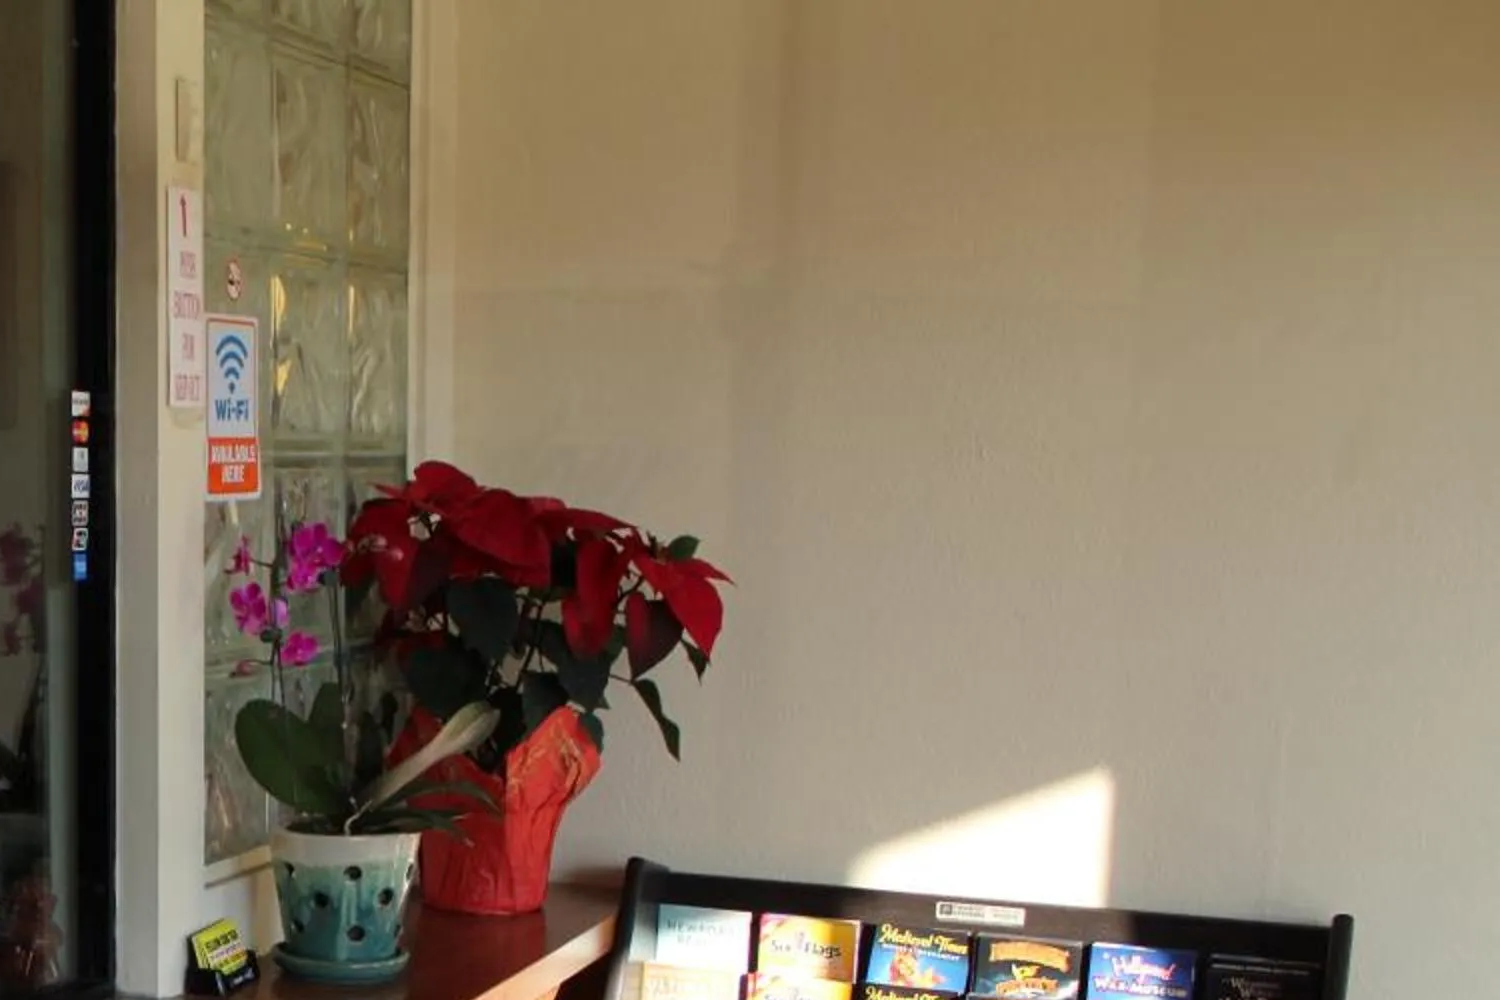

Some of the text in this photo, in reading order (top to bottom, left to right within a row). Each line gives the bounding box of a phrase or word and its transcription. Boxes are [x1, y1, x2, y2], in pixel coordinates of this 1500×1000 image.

[215, 397, 249, 422] Wi-Fi
[221, 464, 245, 483] HERE
[804, 939, 843, 960] Flags
[879, 924, 933, 948] Medieval
[934, 934, 968, 955] Times
